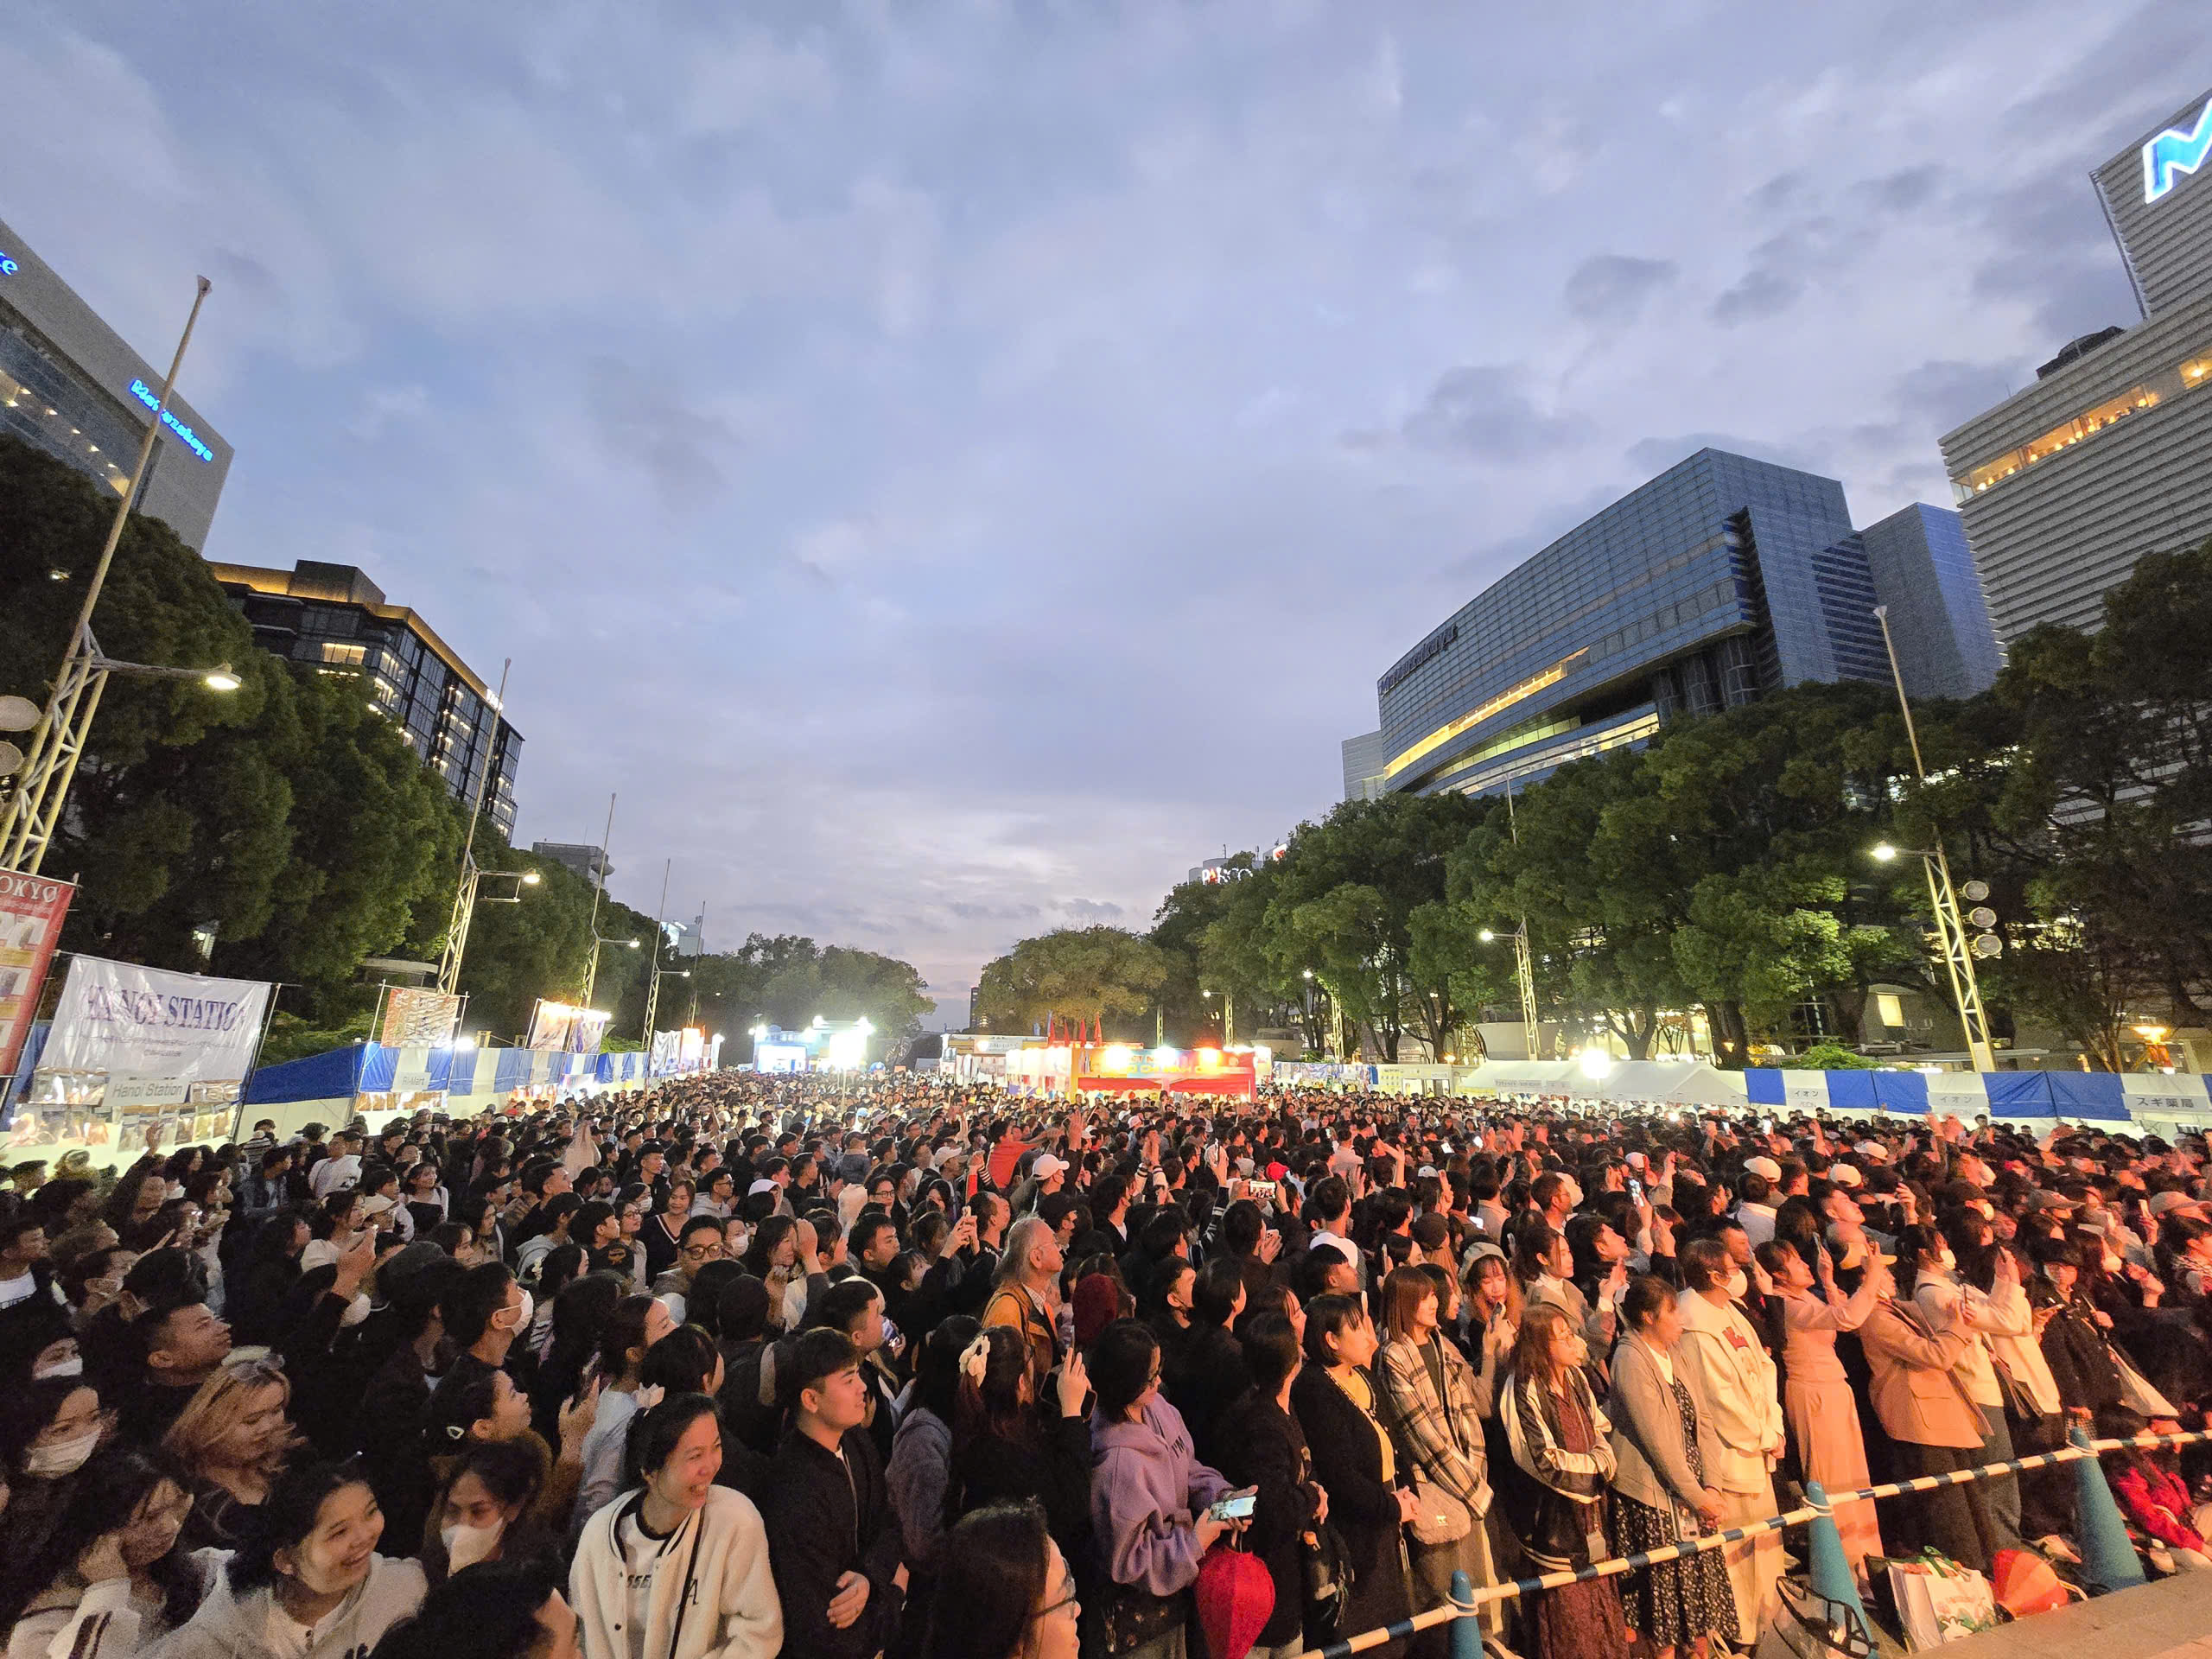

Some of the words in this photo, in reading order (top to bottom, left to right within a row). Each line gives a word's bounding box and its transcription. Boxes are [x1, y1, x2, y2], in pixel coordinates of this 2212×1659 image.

[112, 1084, 143, 1098] Hanoi
[145, 1083, 183, 1097] Station
[1939, 1096, 1973, 1104] イオン
[2136, 1097, 2195, 1109] スギ薬局
